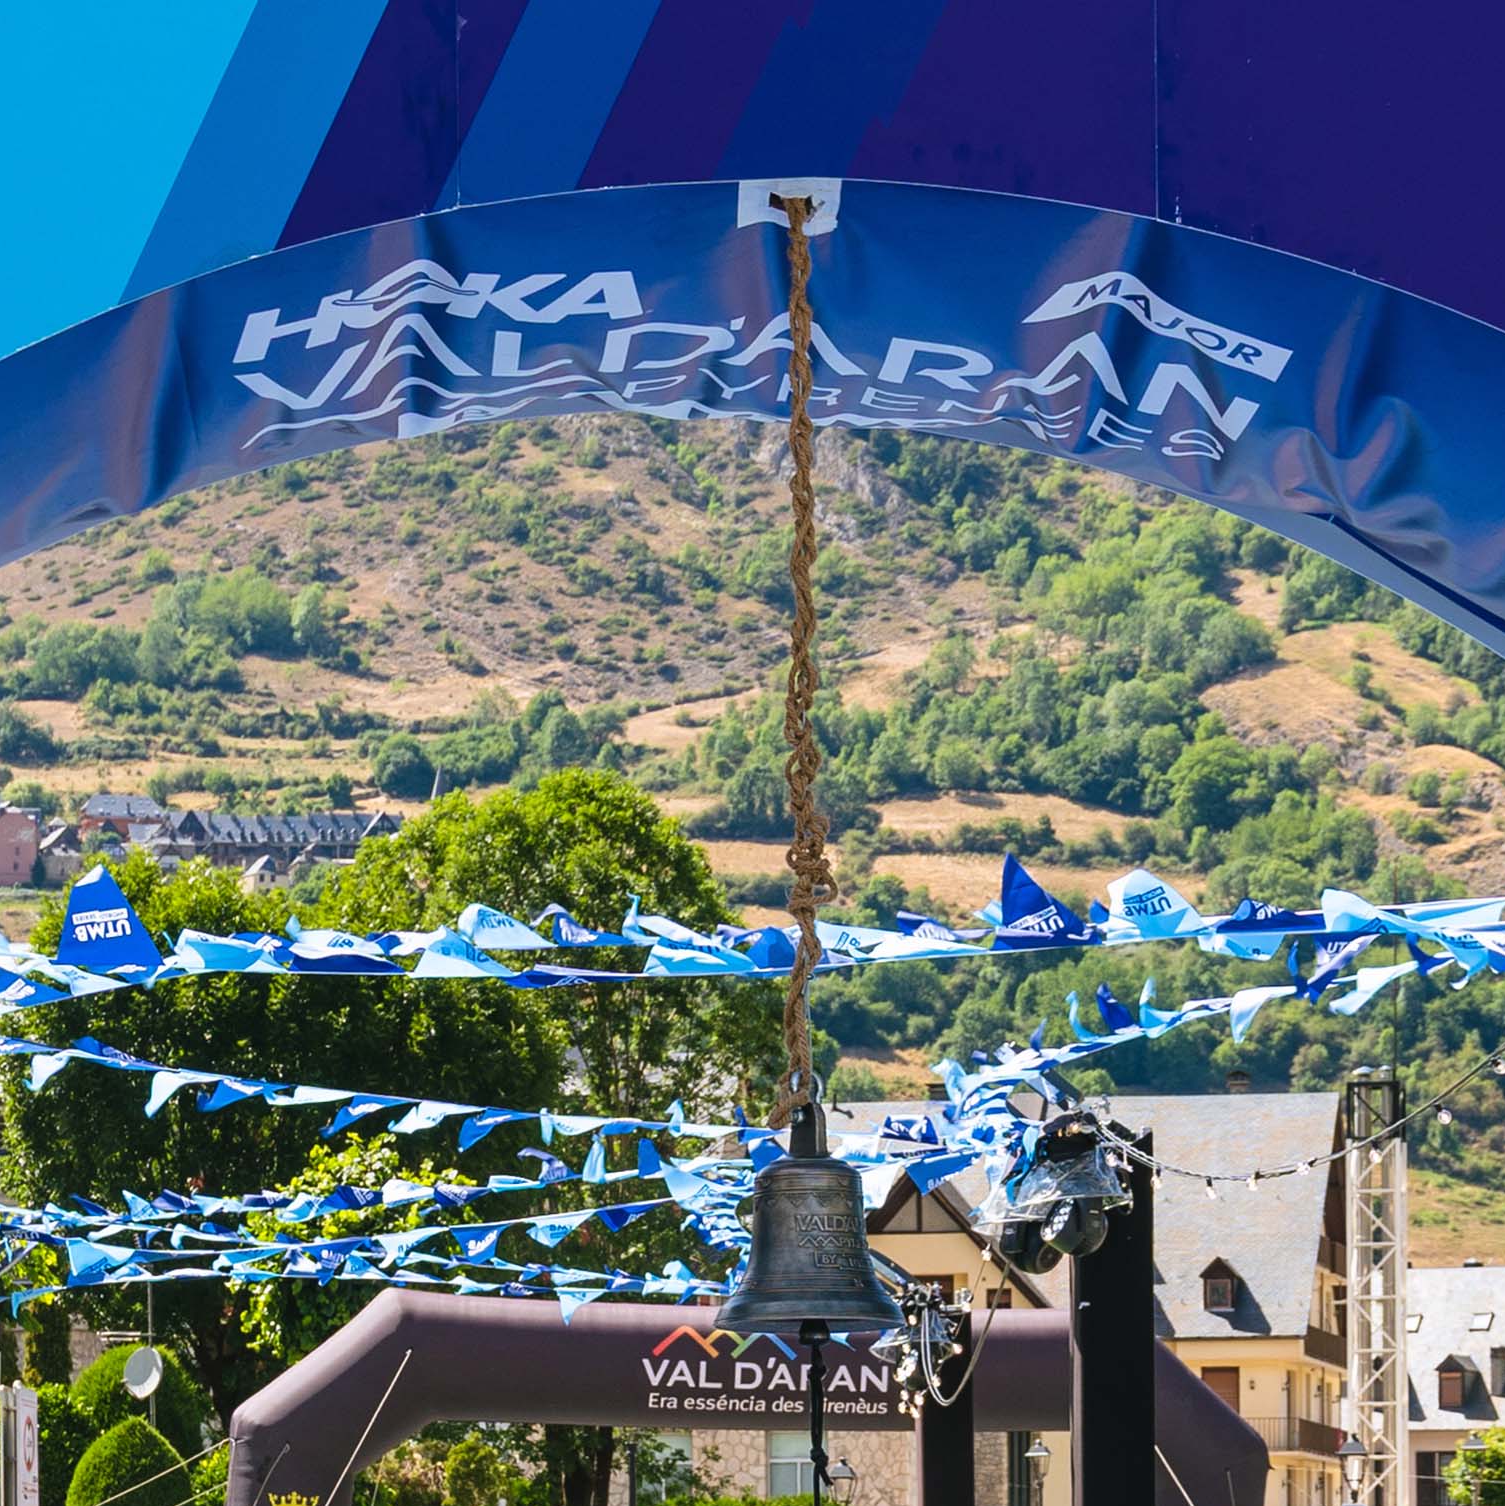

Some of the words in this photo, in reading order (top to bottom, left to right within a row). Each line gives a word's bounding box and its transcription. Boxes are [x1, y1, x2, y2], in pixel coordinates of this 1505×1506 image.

[233, 259, 643, 363] HOKA
[1072, 278, 1262, 366] MAJOR
[642, 1358, 722, 1389] VAL
[648, 1393, 677, 1409] Era
[772, 1395, 804, 1413] des
[810, 1398, 888, 1415] irenèus
